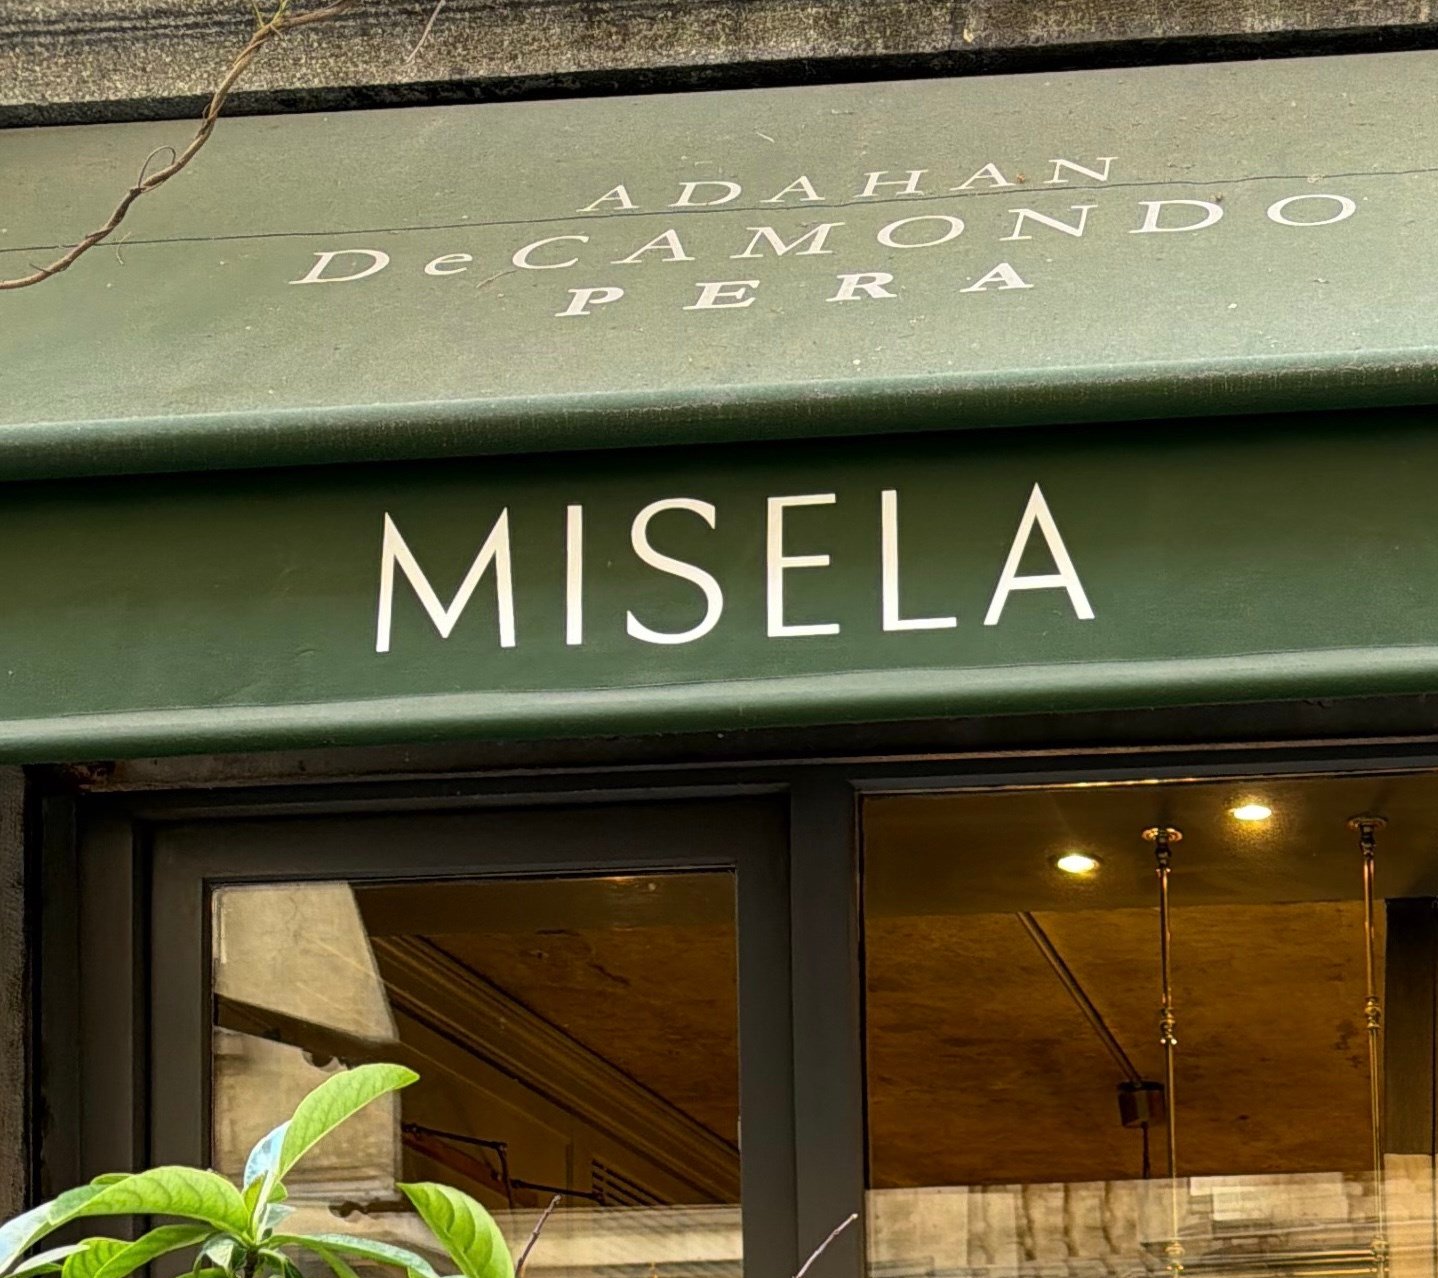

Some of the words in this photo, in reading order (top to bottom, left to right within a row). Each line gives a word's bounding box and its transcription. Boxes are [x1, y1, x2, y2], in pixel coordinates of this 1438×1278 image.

[577, 155, 1119, 212] ADAHAN
[289, 193, 1358, 286] DeCAMONDO
[555, 261, 1034, 318] PERA
[375, 481, 1096, 653] MISELA
